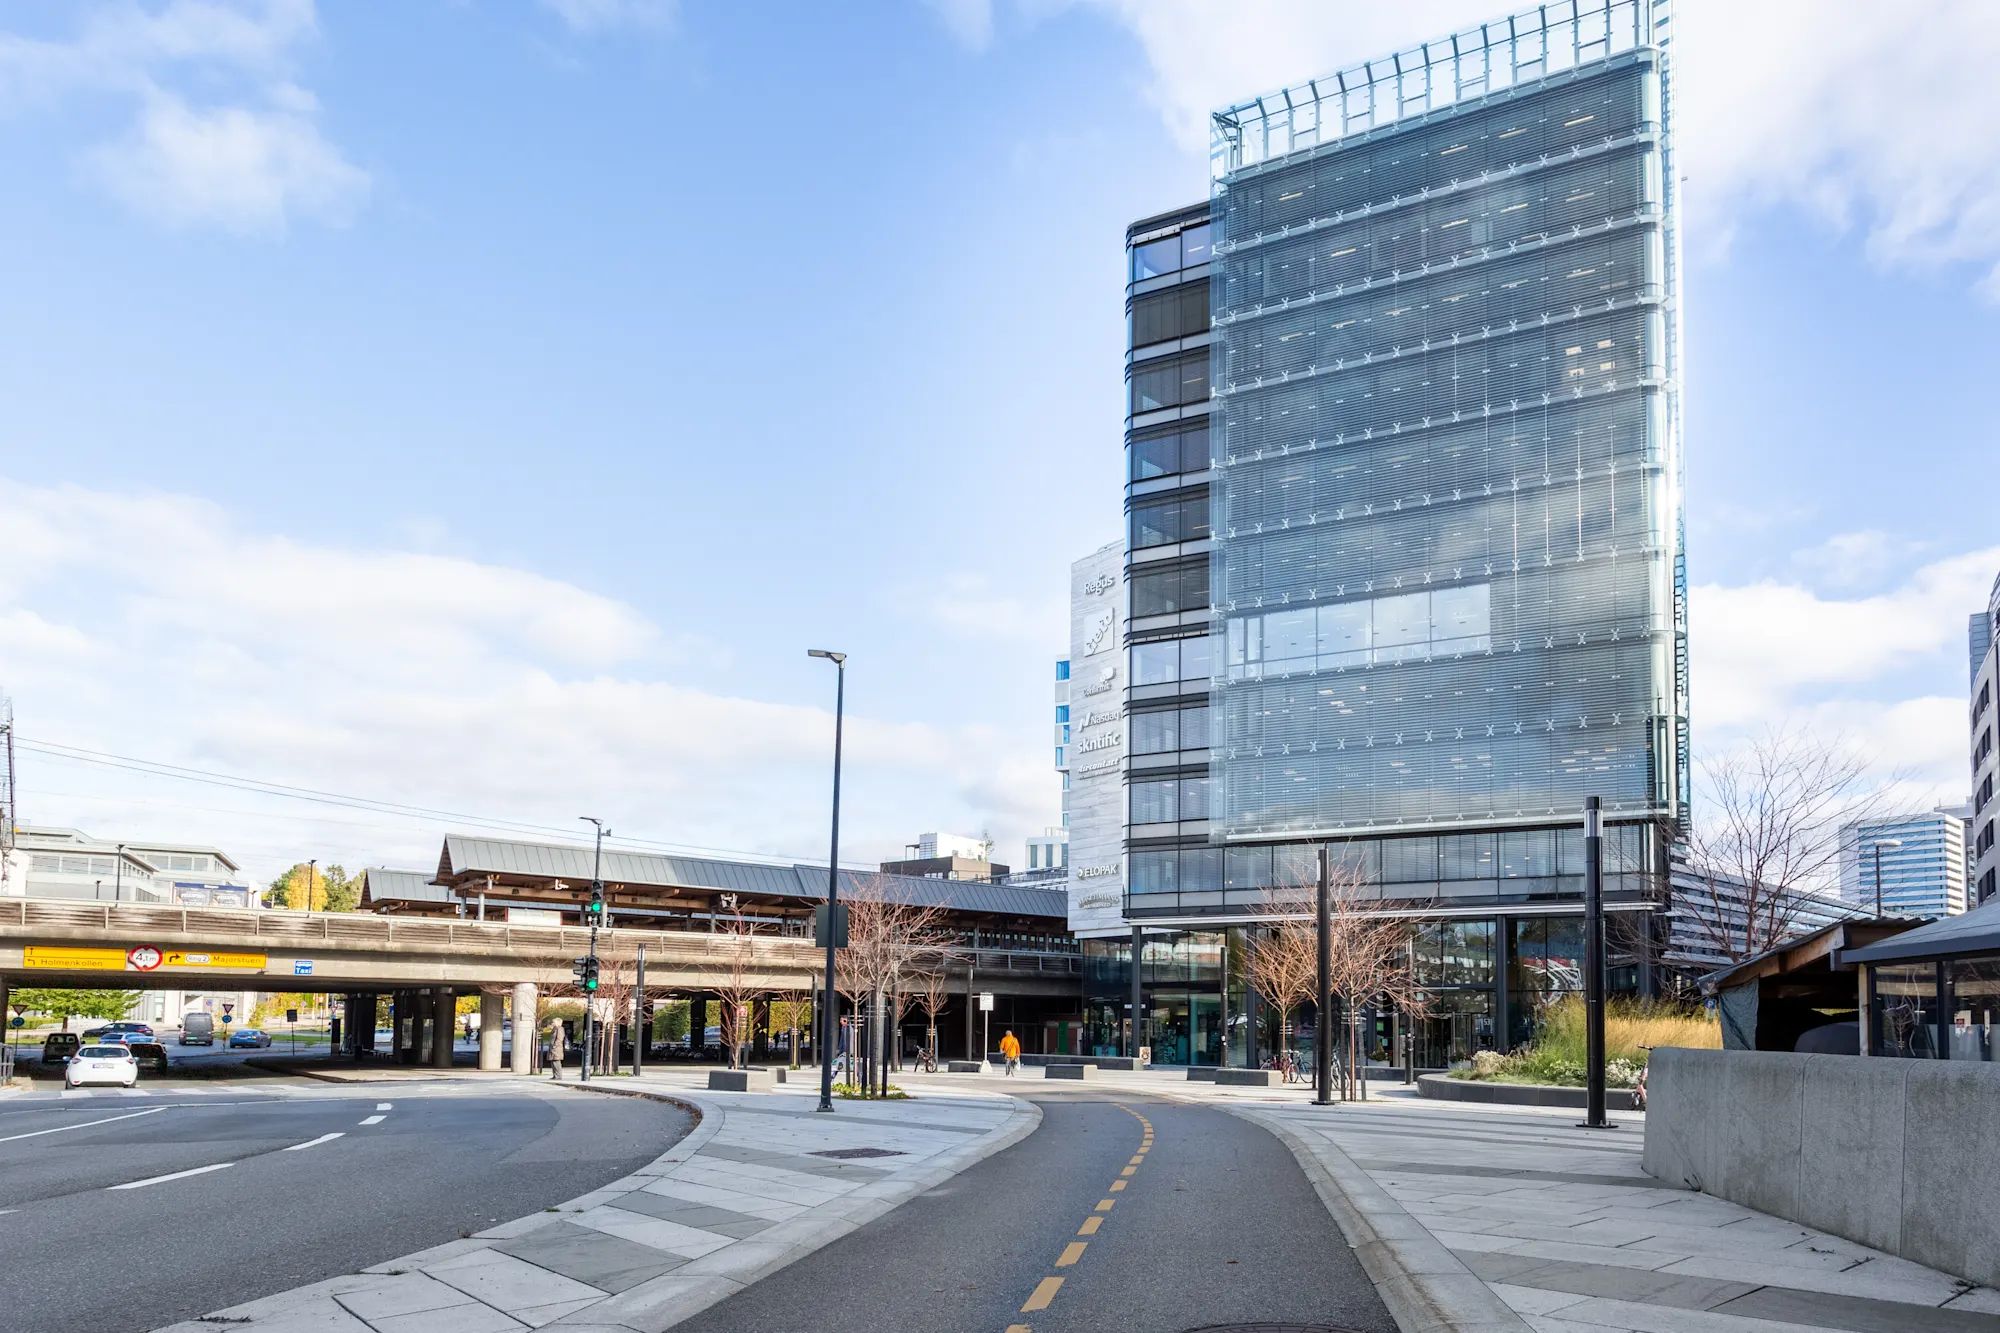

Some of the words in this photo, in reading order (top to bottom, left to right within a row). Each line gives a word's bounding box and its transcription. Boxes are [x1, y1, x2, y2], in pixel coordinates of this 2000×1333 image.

[1085, 574, 1115, 596] Regus
[1090, 711, 1120, 725] Nasdaq
[1078, 731, 1120, 753] skntific
[1084, 863, 1117, 877] ELOPAK
[40, 958, 103, 967] Holmenkollen
[213, 955, 261, 964] Majorstuen
[296, 967, 312, 975] Taxi
